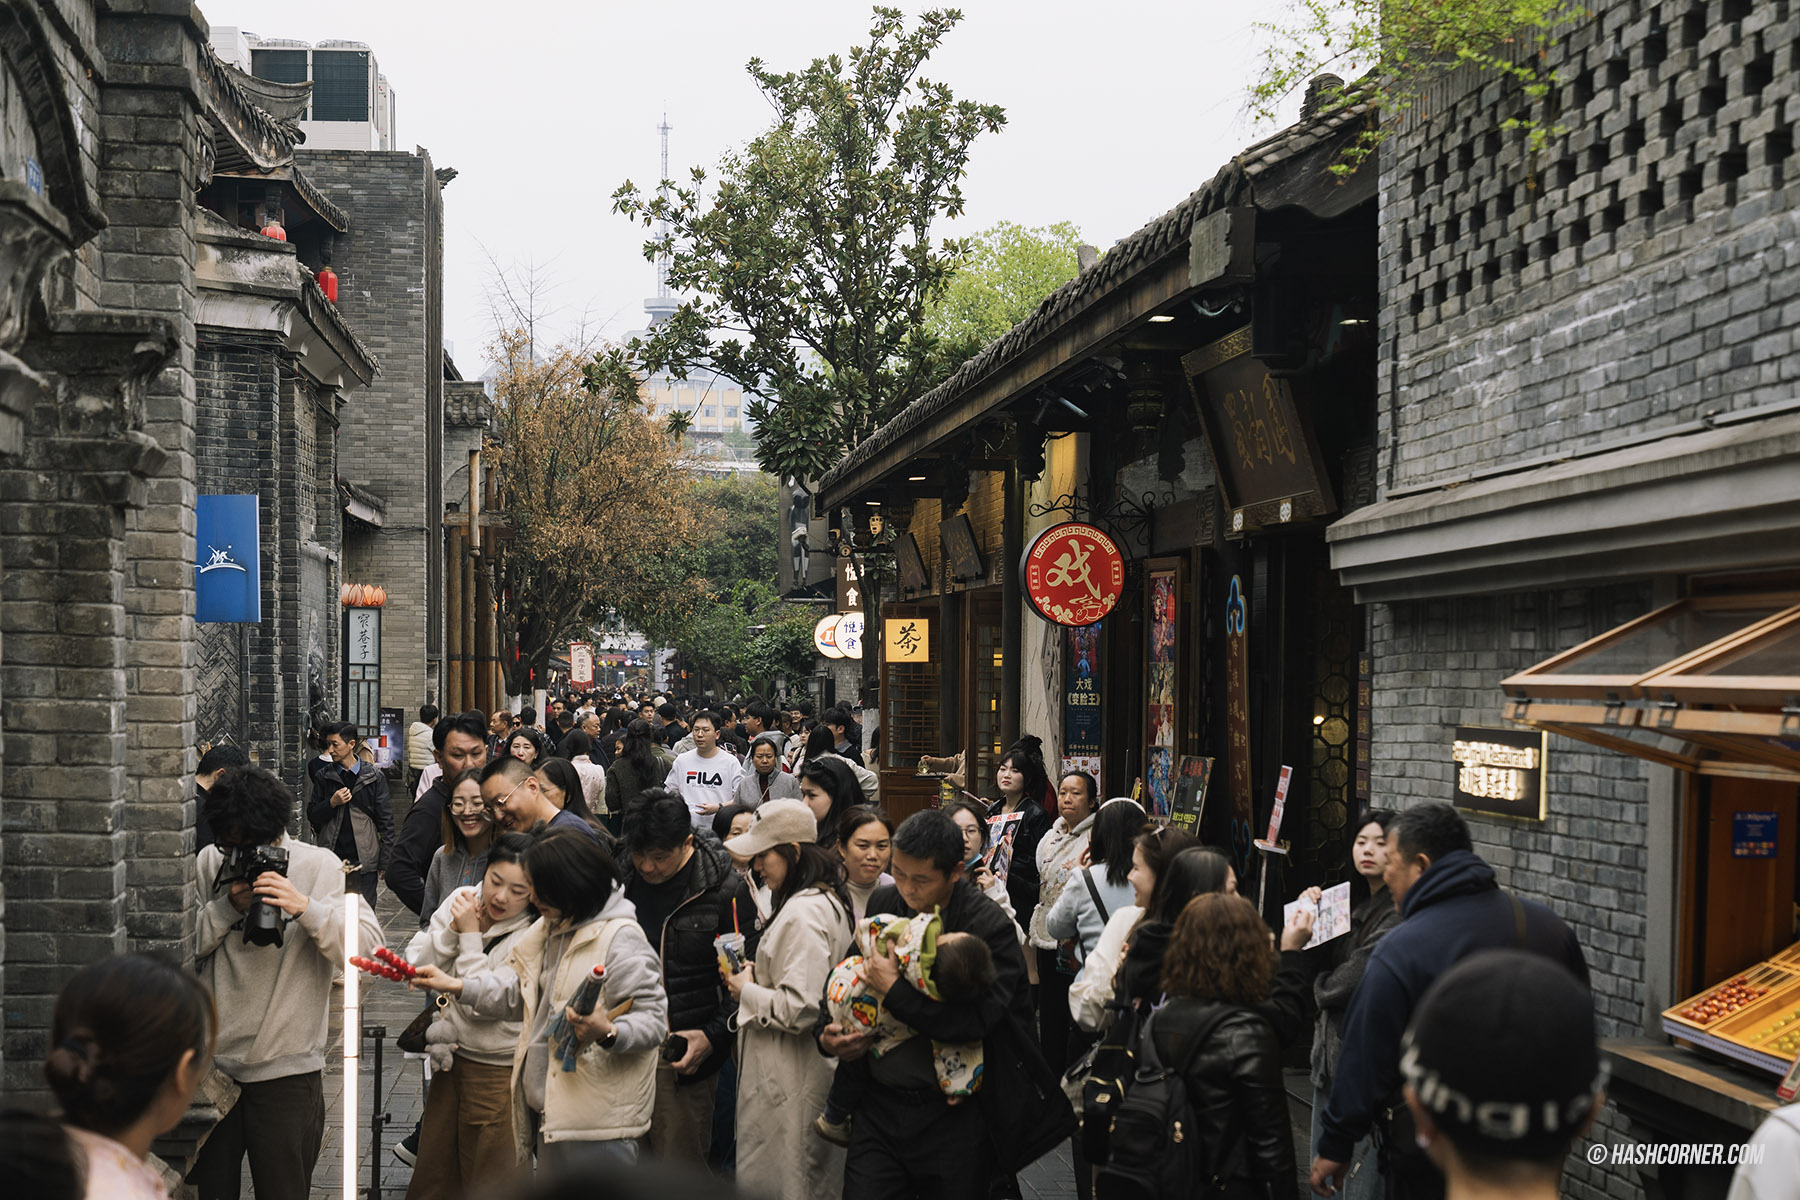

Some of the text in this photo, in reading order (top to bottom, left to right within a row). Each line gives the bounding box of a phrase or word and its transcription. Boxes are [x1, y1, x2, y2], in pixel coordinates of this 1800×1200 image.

[1045, 539, 1101, 600] 戏
[357, 613, 371, 660] 窄巷子
[893, 622, 922, 657] 茶
[1075, 677, 1093, 691] 大戏
[686, 771, 723, 786] FILA
